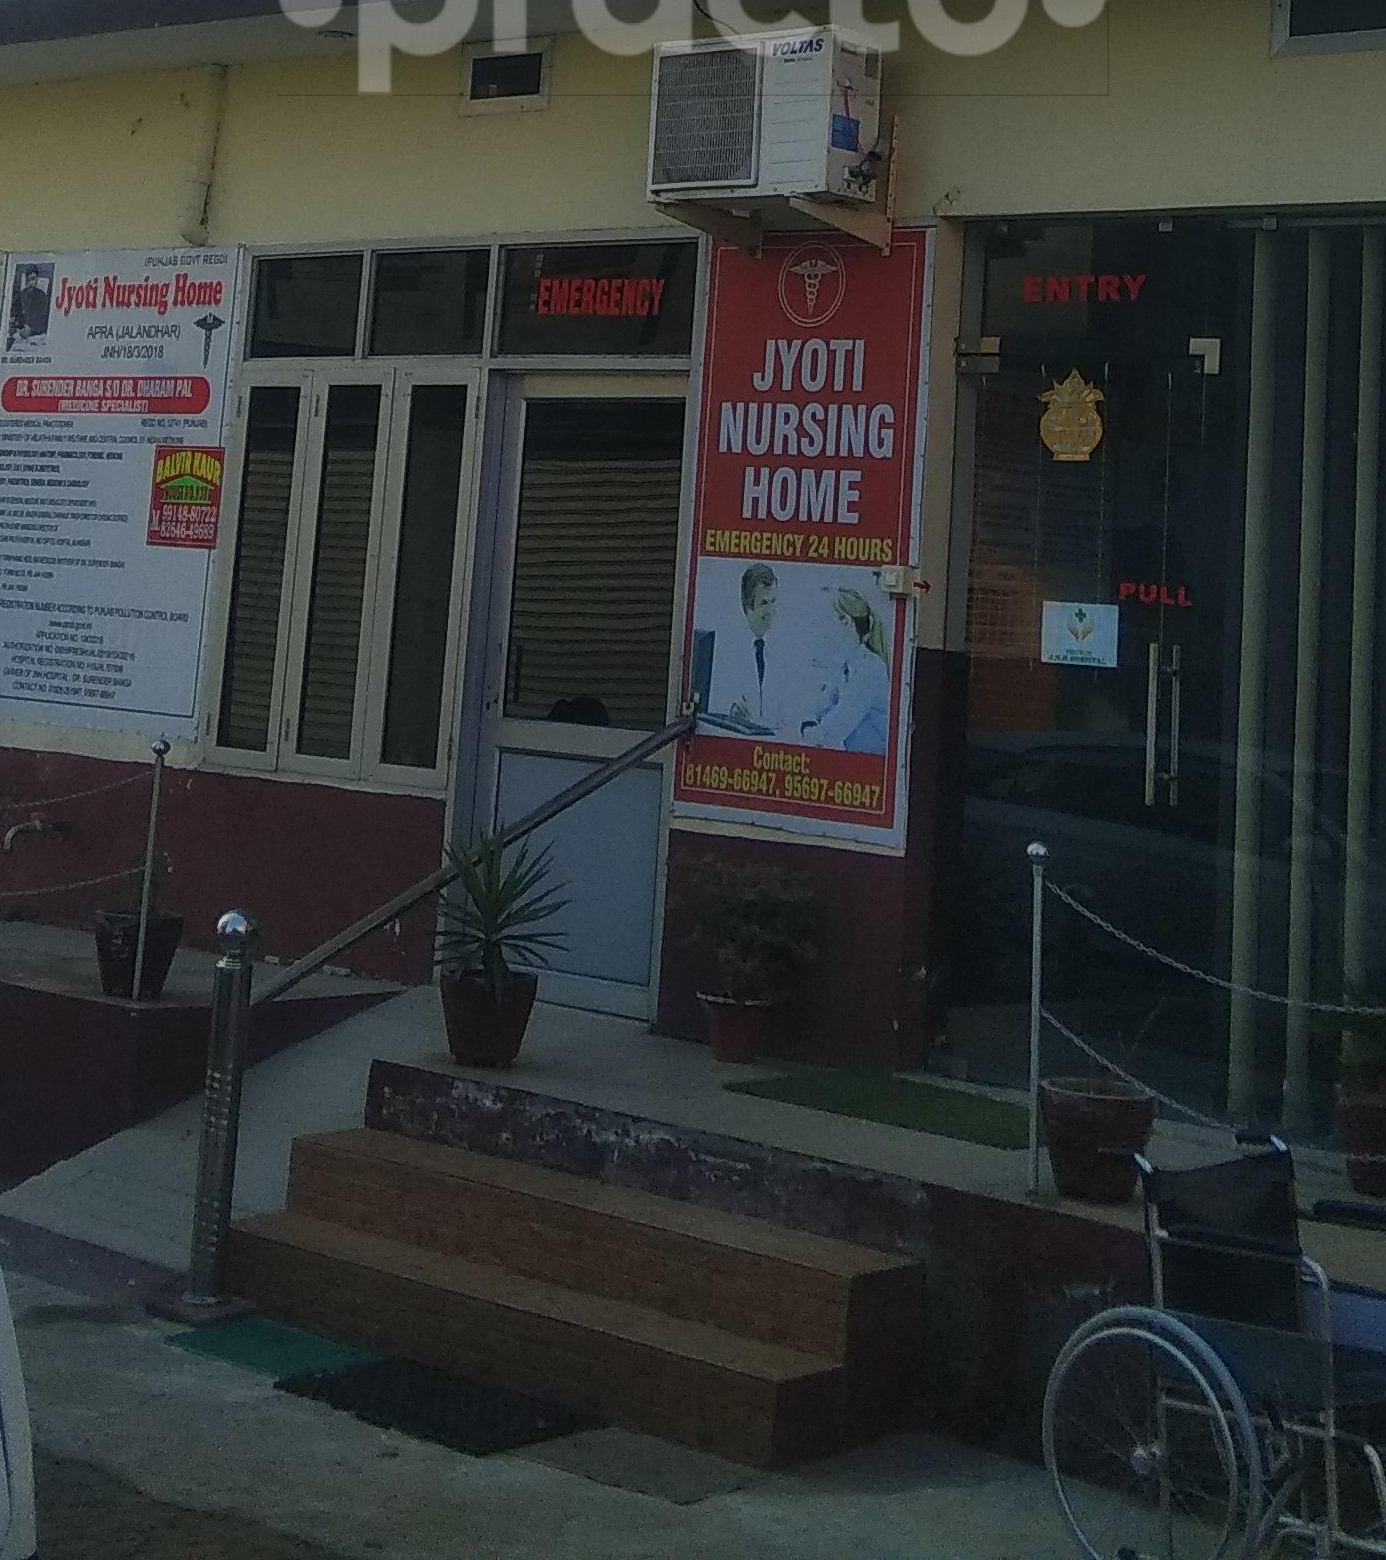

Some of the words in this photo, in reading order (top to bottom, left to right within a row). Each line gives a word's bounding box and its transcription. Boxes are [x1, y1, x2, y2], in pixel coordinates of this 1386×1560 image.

[772, 38, 824, 57] VOLTAS
[55, 276, 99, 317] Jyoti
[101, 274, 171, 316] Nursing
[172, 272, 223, 308] Home
[538, 277, 665, 317] EMERGENCY
[1022, 274, 1146, 304] ENTRY
[86, 325, 114, 340] APRA
[115, 324, 181, 341] (JALANDHAR)
[752, 338, 866, 393] JYOTI
[175, 379, 193, 397] PAL
[718, 402, 896, 459] NURSING
[155, 450, 192, 484] BALVIR
[193, 451, 221, 486] KAUR
[741, 466, 862, 526] HOME
[705, 528, 804, 558] EMERGENCY
[808, 534, 831, 559] 24
[834, 536, 894, 564] HOURS
[1118, 581, 1193, 608] PULL
[753, 745, 810, 775] Contact:
[783, 777, 881, 809] 95697-66947
